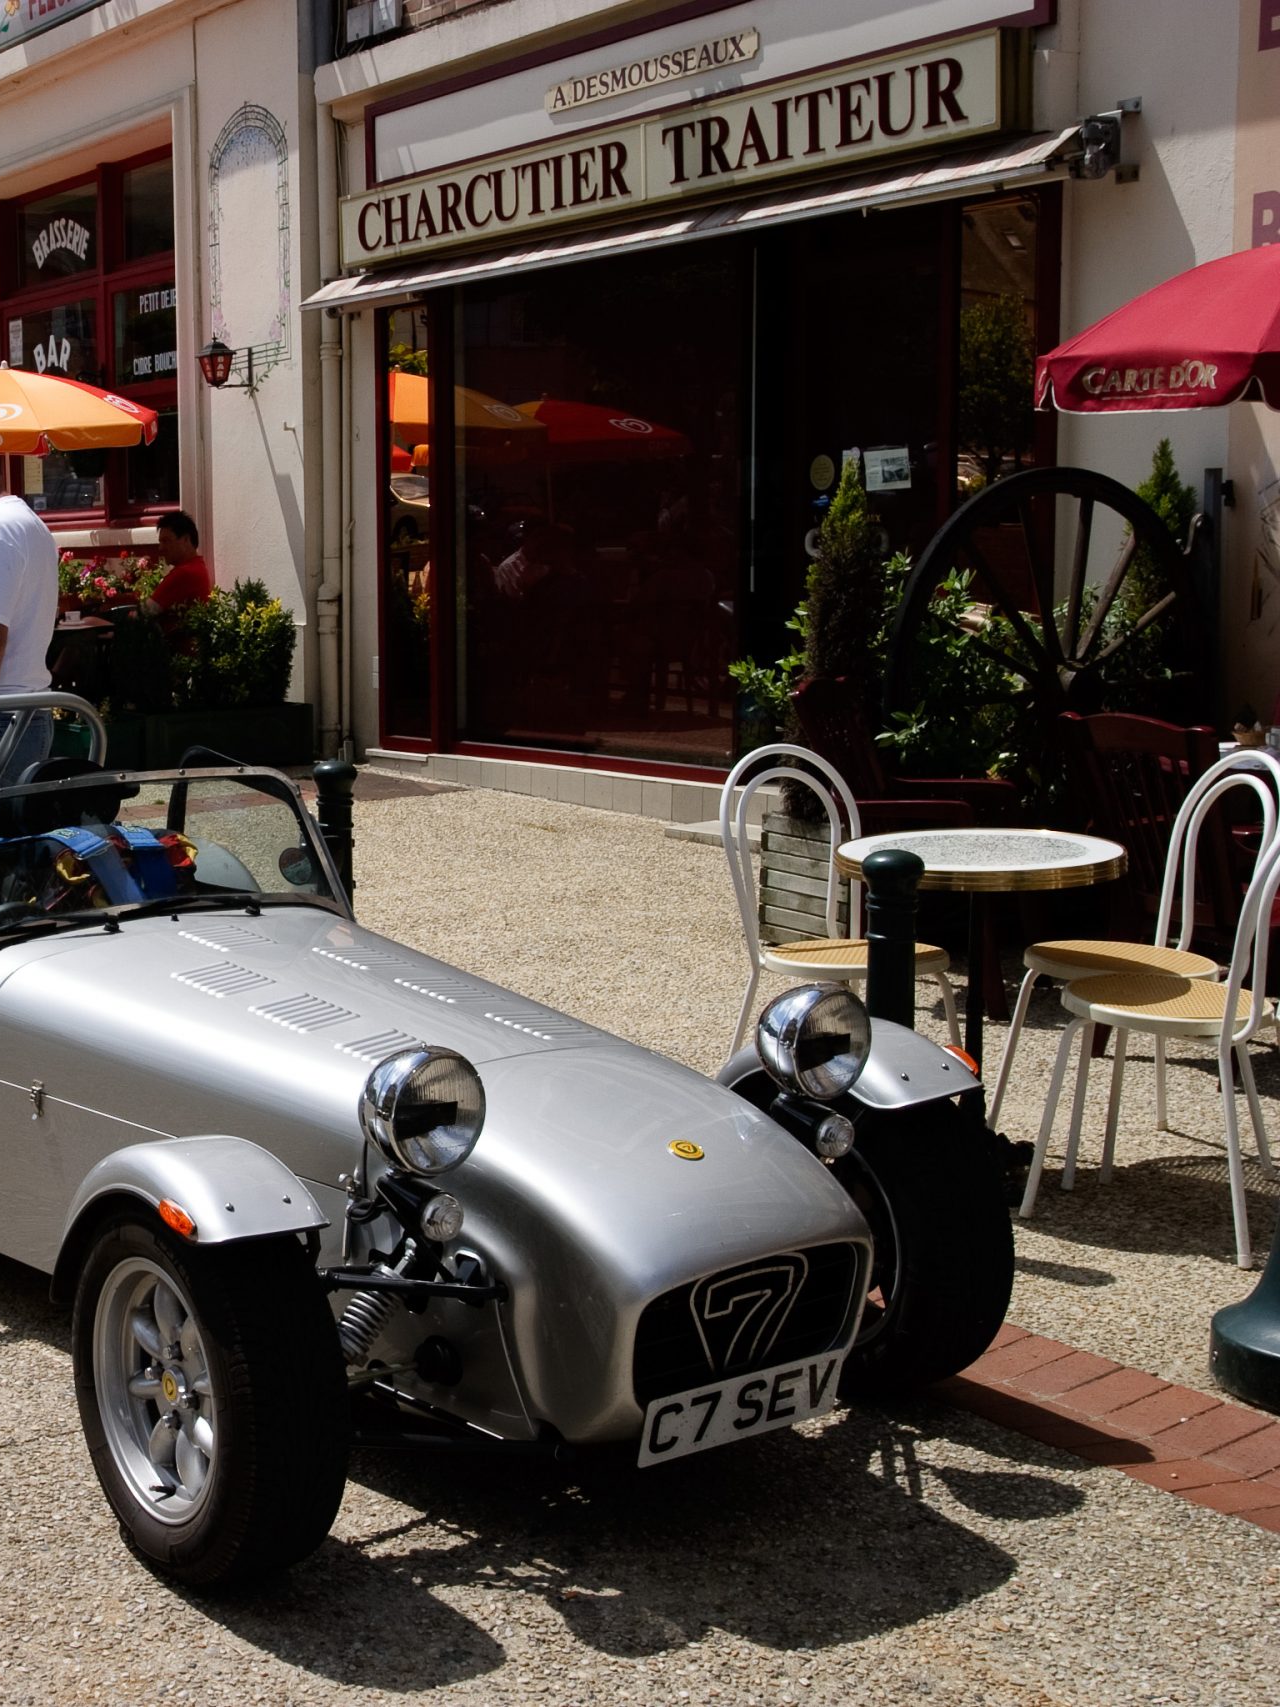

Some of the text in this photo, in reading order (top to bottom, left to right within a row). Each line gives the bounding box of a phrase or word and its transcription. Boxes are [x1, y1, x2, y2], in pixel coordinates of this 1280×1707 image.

[573, 34, 746, 103] DESMOUSSEAUX
[358, 57, 969, 251] CHARCUTIER TRAITEUR
[32, 218, 90, 269] BRASSERIE
[139, 291, 160, 315] PETIT
[33, 335, 70, 374] BAR
[133, 355, 153, 376] CIDRE
[1082, 367, 1164, 395] CARTE
[1169, 358, 1218, 390] D'OR
[702, 1262, 798, 1373] 7
[648, 1358, 839, 1455] C7 SEV
